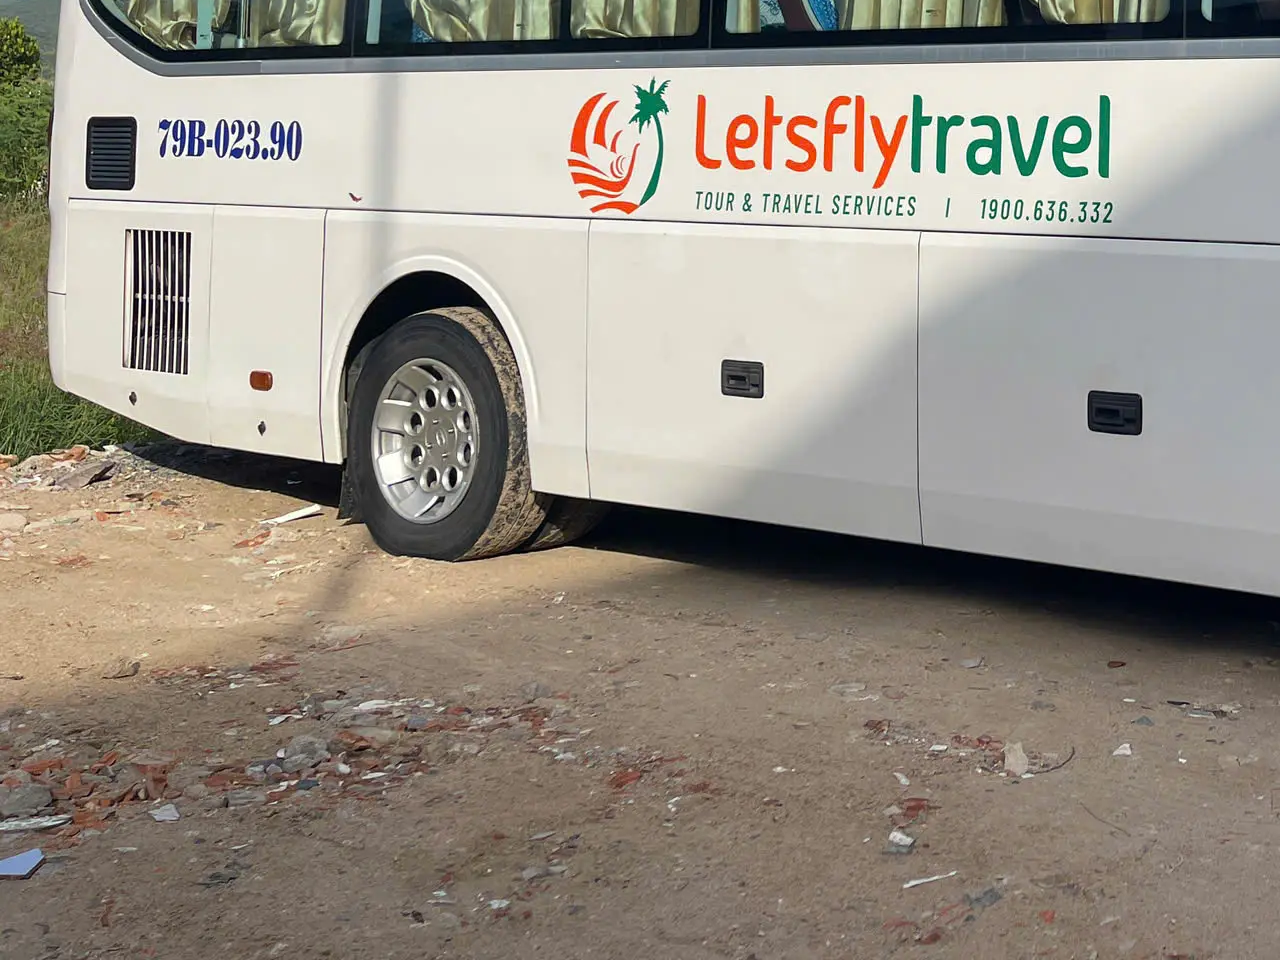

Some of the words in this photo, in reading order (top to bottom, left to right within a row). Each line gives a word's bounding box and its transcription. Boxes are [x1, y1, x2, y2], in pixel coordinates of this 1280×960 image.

[158, 119, 303, 161] 79B-023.90
[695, 93, 1111, 189] Letsflytravel
[695, 191, 735, 212] TOUR
[742, 193, 752, 212] &
[762, 193, 823, 214] TRAVEL
[831, 194, 917, 217] SERVICES
[980, 198, 1114, 224] 1900.636.332
